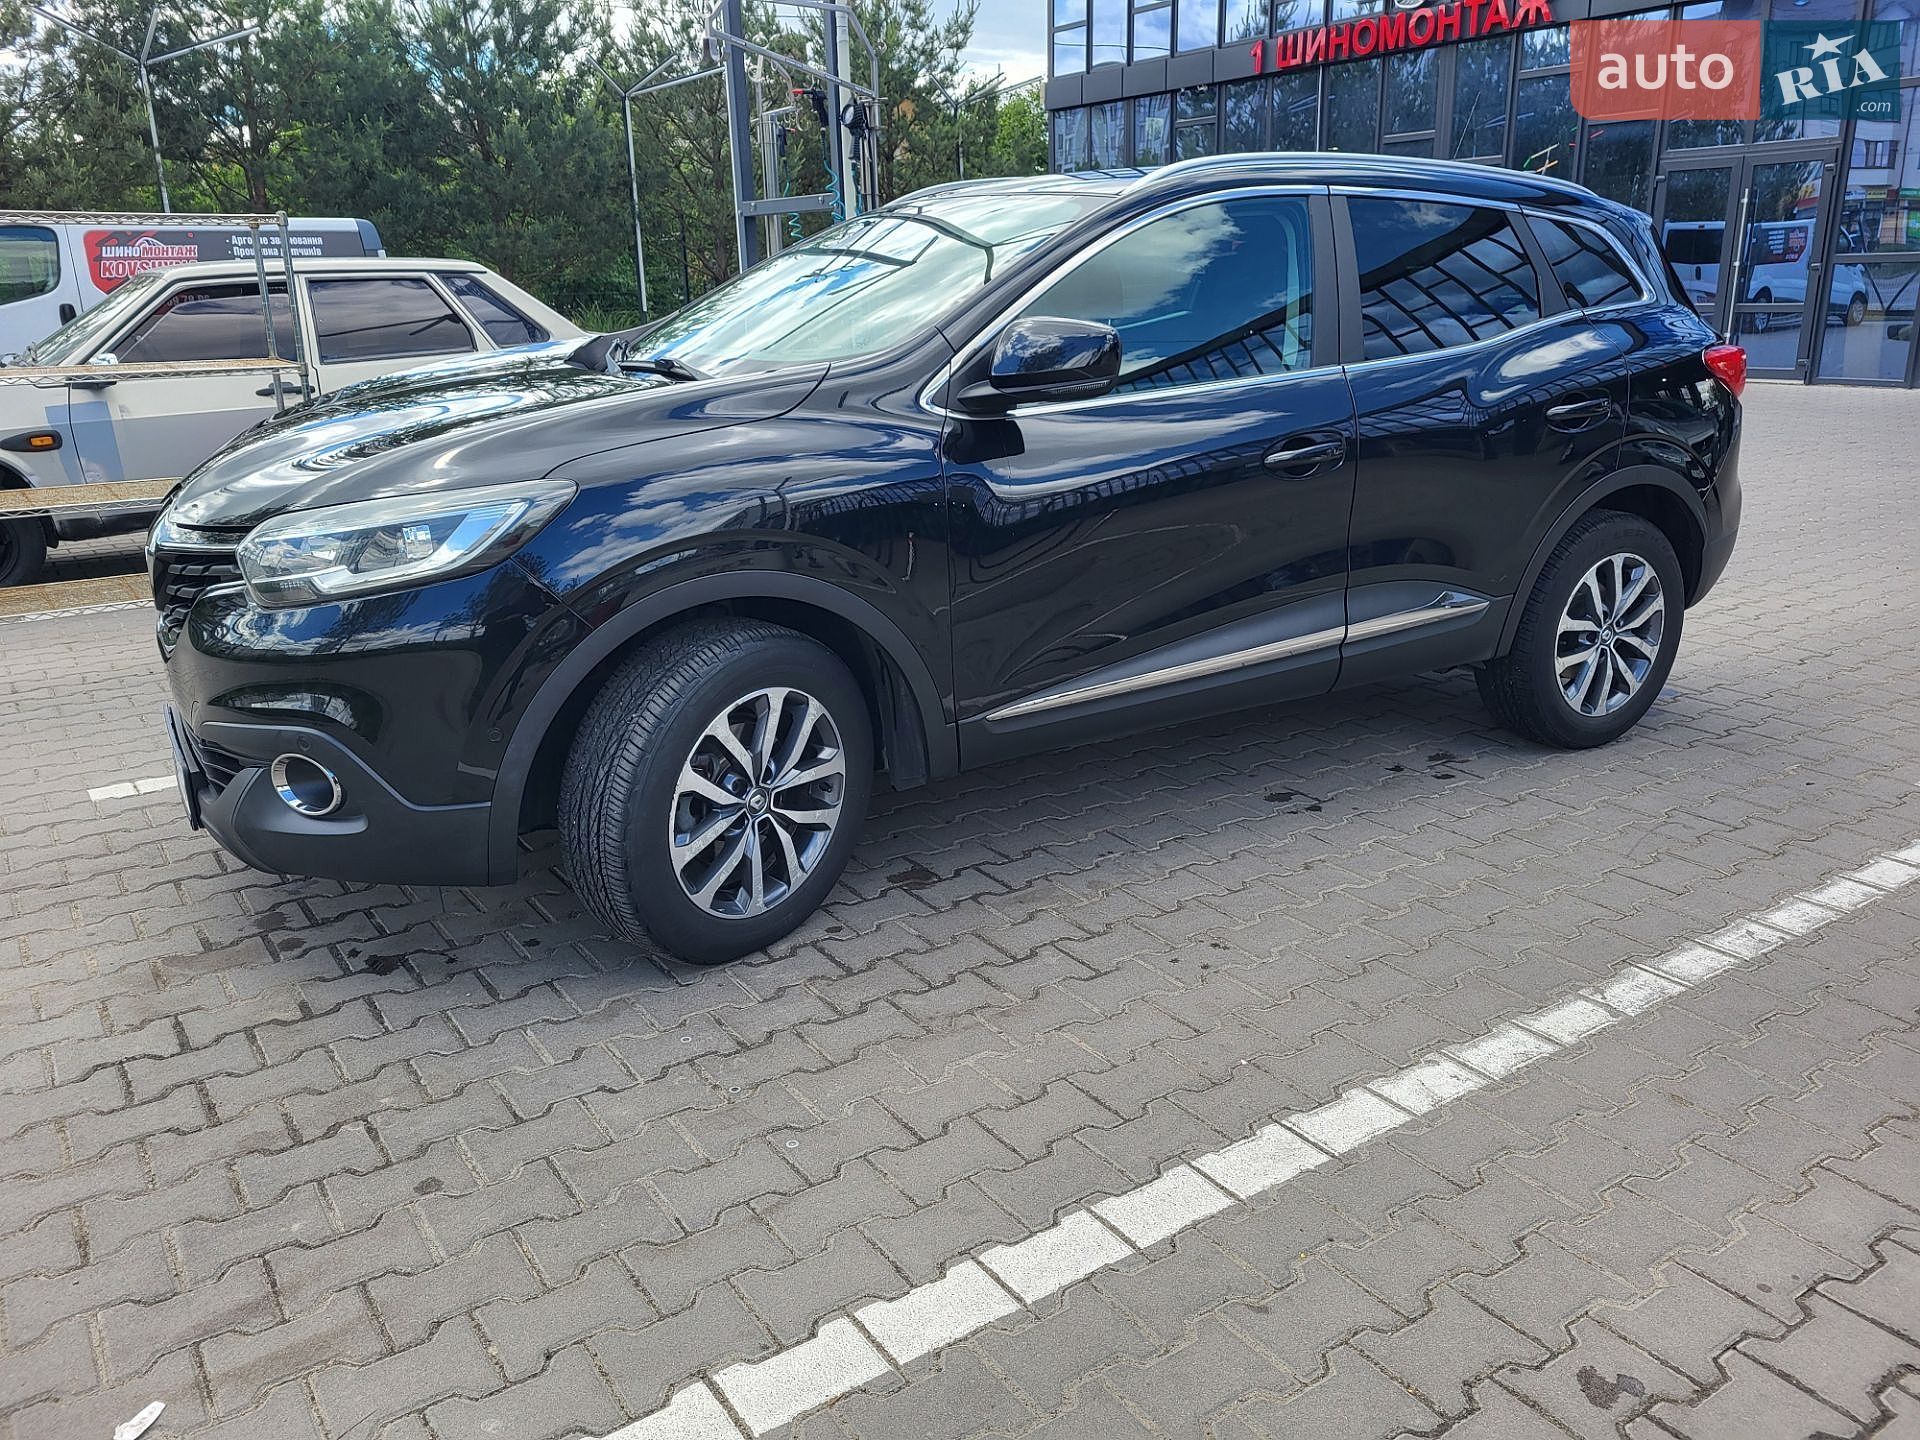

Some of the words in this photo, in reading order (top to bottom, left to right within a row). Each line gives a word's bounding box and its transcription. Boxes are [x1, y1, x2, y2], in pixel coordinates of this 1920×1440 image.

[1251, 40, 1263, 74] 1
[1276, 0, 1554, 69] ШИНОМОНТАЖ
[102, 245, 198, 258] ШИНОМОНТАЖ
